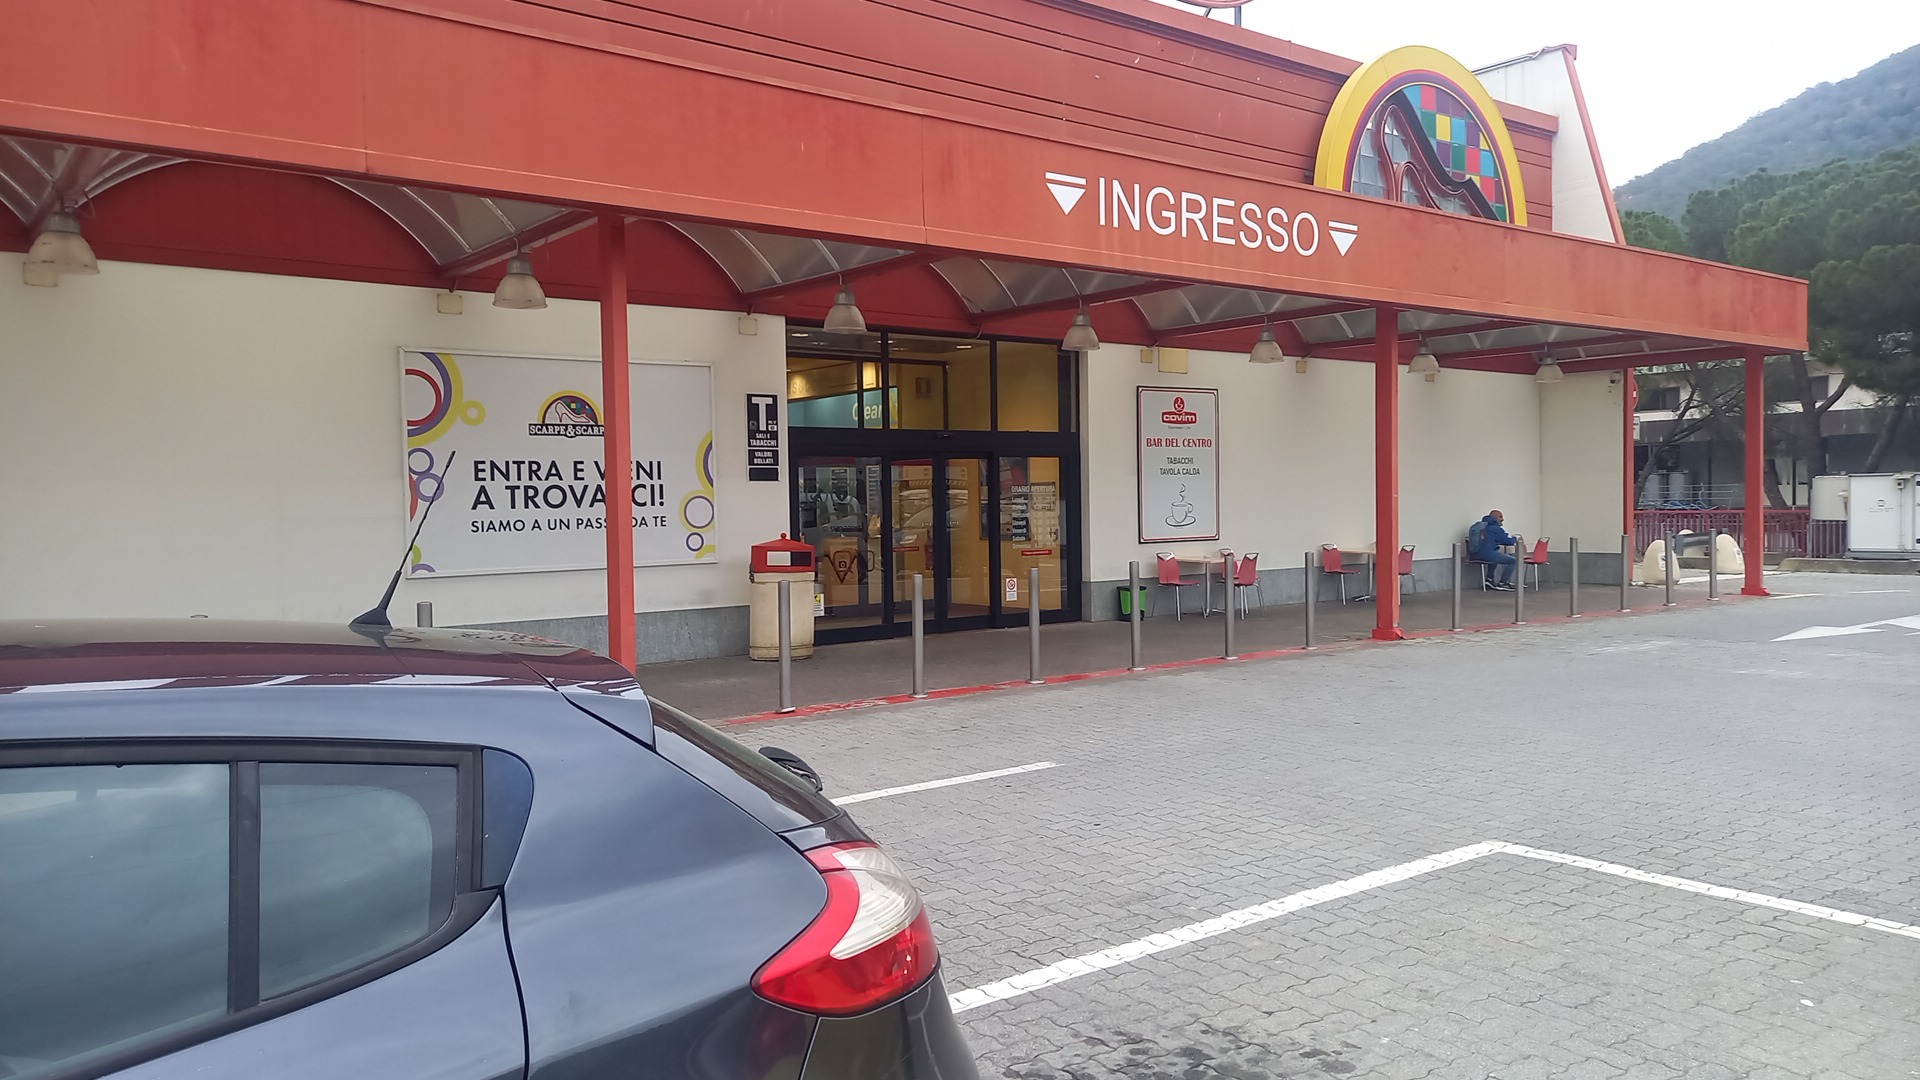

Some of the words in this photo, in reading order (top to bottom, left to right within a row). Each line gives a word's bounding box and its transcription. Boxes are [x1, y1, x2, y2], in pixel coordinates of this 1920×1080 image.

[1099, 176, 1319, 257] INGRESSO
[751, 396, 773, 431] T
[1163, 412, 1196, 422] covim
[529, 424, 604, 437] SCARPE&SCARP
[750, 439, 777, 447] TABACCHI
[1146, 437, 1163, 448] BAR
[1165, 437, 1180, 448] DEL
[1182, 438, 1212, 448] CENTRO
[1166, 456, 1194, 465] TABACCHI
[473, 460, 565, 482] ENTRA
[573, 460, 585, 481] E
[593, 460, 662, 481] VNI
[1159, 467, 1181, 476] TAVOLA
[1181, 467, 1201, 476] CALDA
[471, 485, 495, 510] A
[505, 483, 665, 510] TROVACI!
[470, 519, 526, 534] SIAMO
[531, 518, 543, 532] A
[547, 518, 570, 531] UN
[652, 515, 667, 527] TE
